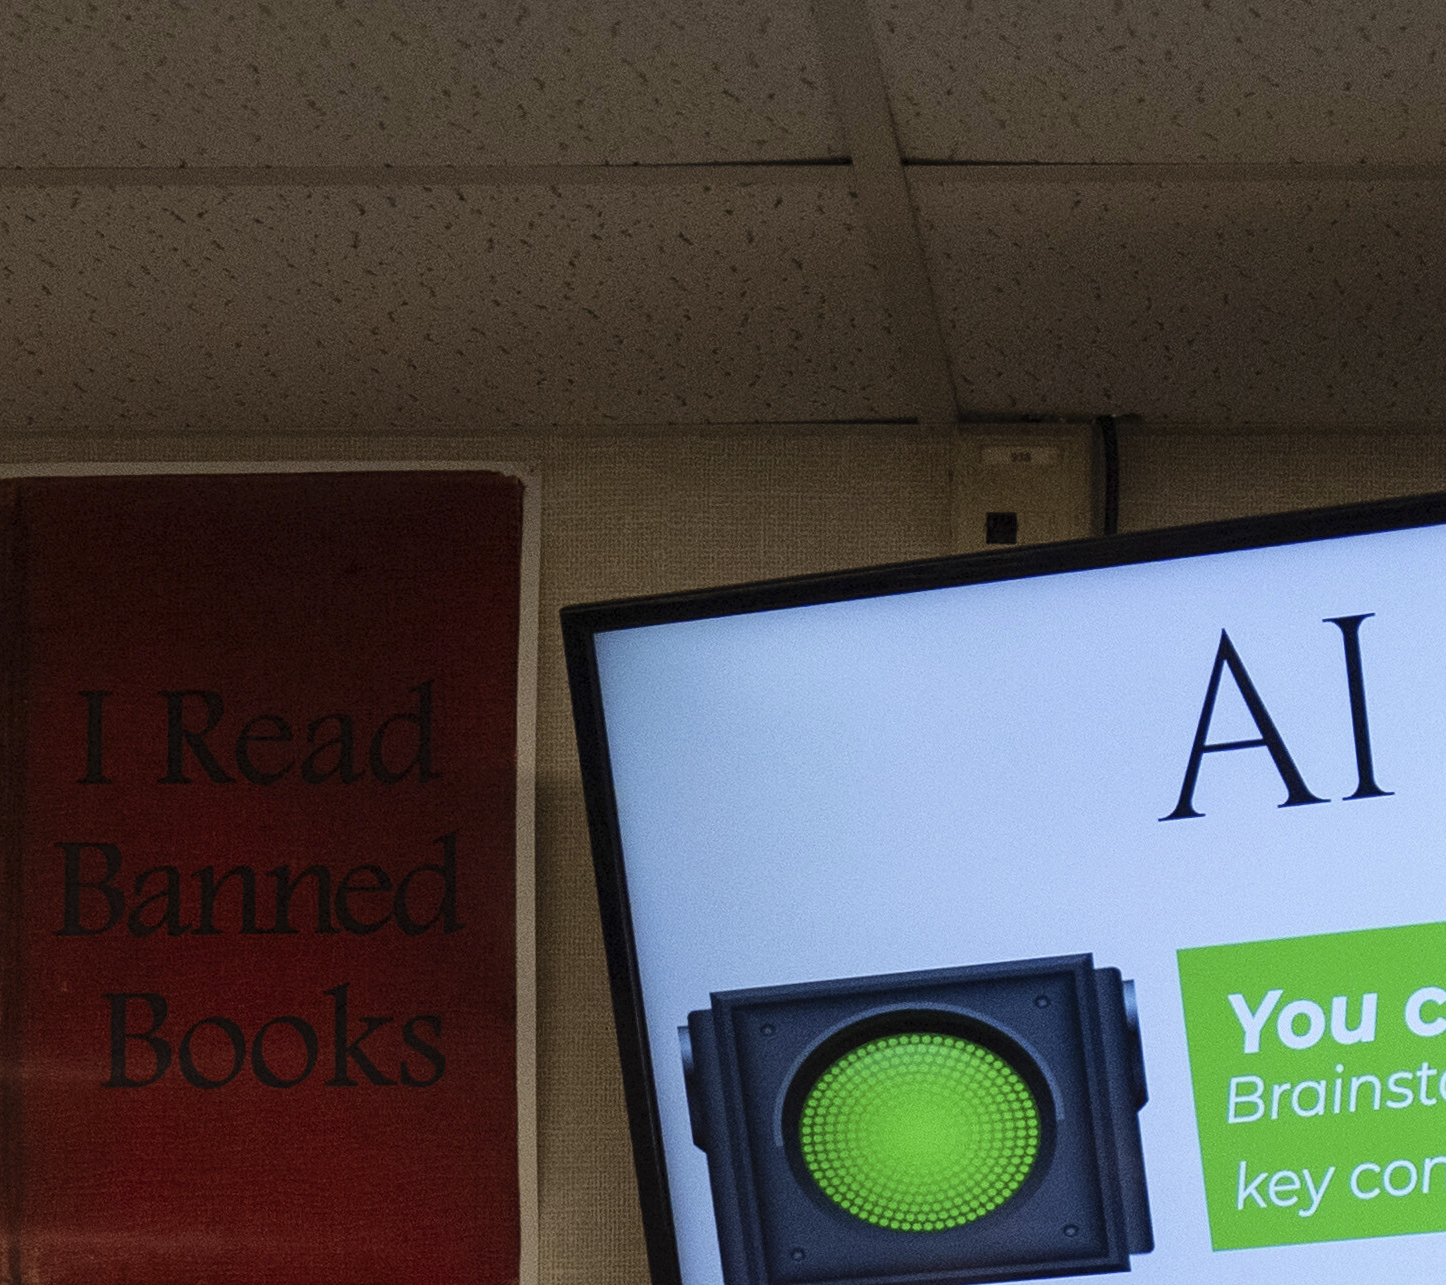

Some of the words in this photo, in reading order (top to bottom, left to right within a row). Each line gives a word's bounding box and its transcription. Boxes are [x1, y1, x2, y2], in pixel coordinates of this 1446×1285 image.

[78, 690, 114, 784] I
[156, 678, 440, 786] Read
[1157, 612, 1395, 822] AI
[54, 828, 464, 936] Banned
[101, 981, 448, 1090] Books
[1227, 988, 1379, 1054] You
[1236, 1160, 1336, 1218] key
